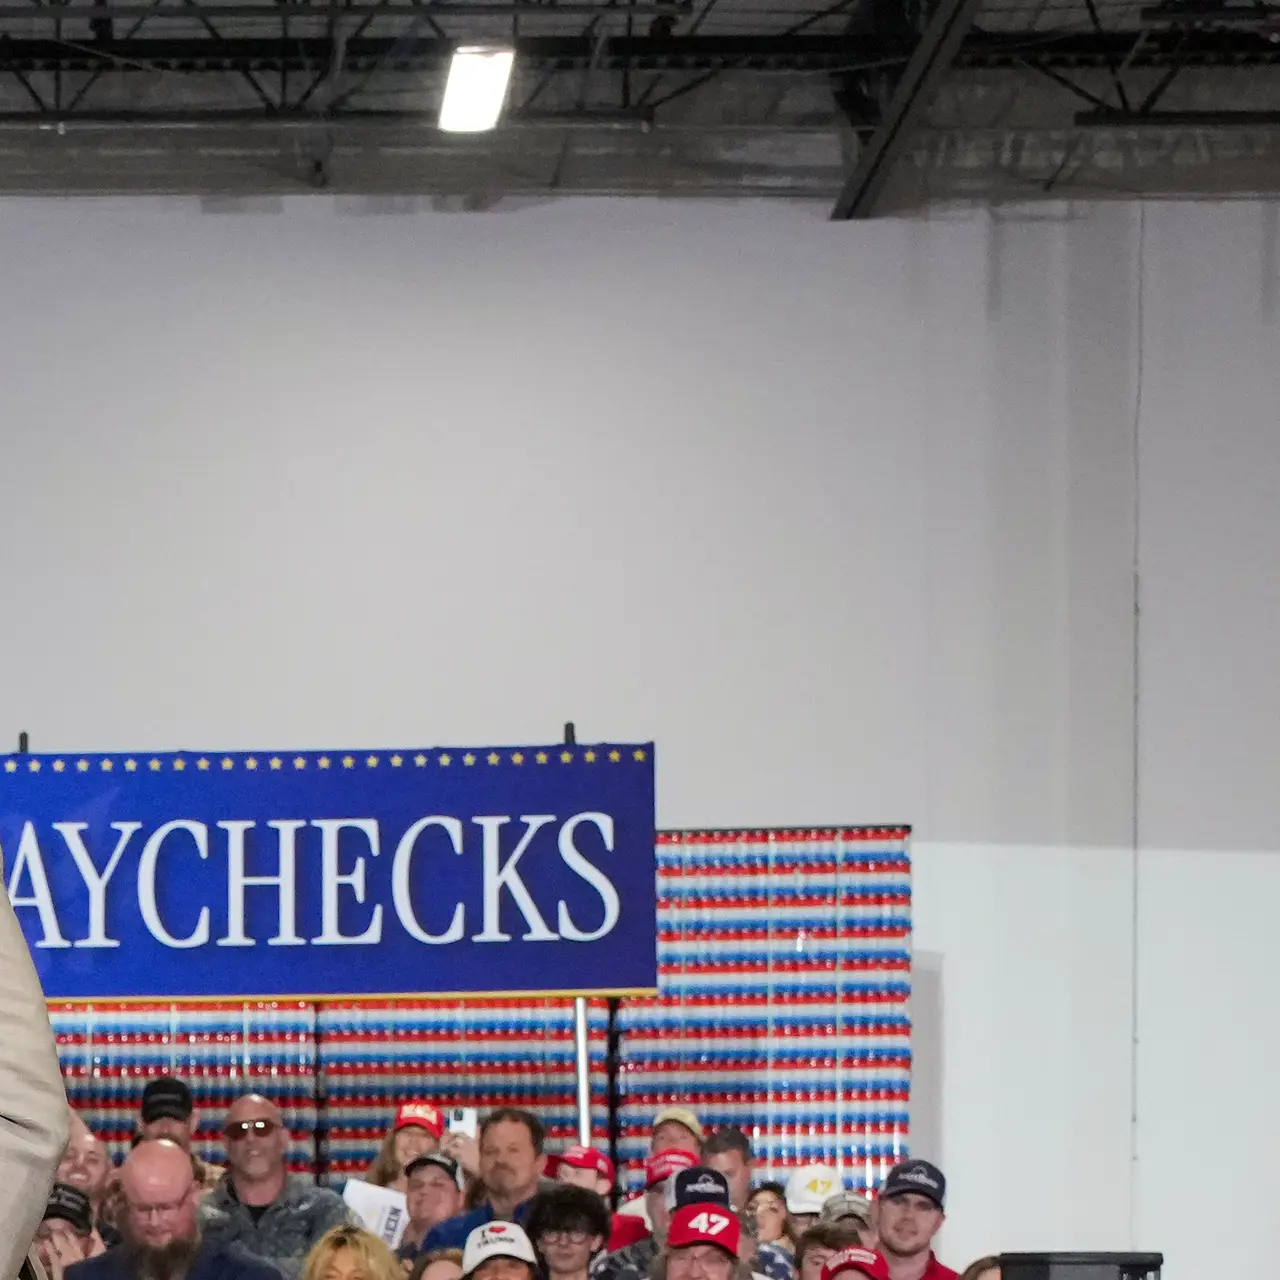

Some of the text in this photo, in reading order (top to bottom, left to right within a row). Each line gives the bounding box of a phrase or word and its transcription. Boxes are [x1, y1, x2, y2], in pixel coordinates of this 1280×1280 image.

[6, 812, 621, 950] AYCHECKS
[804, 1178, 834, 1194] 47
[687, 1211, 730, 1236] 47
